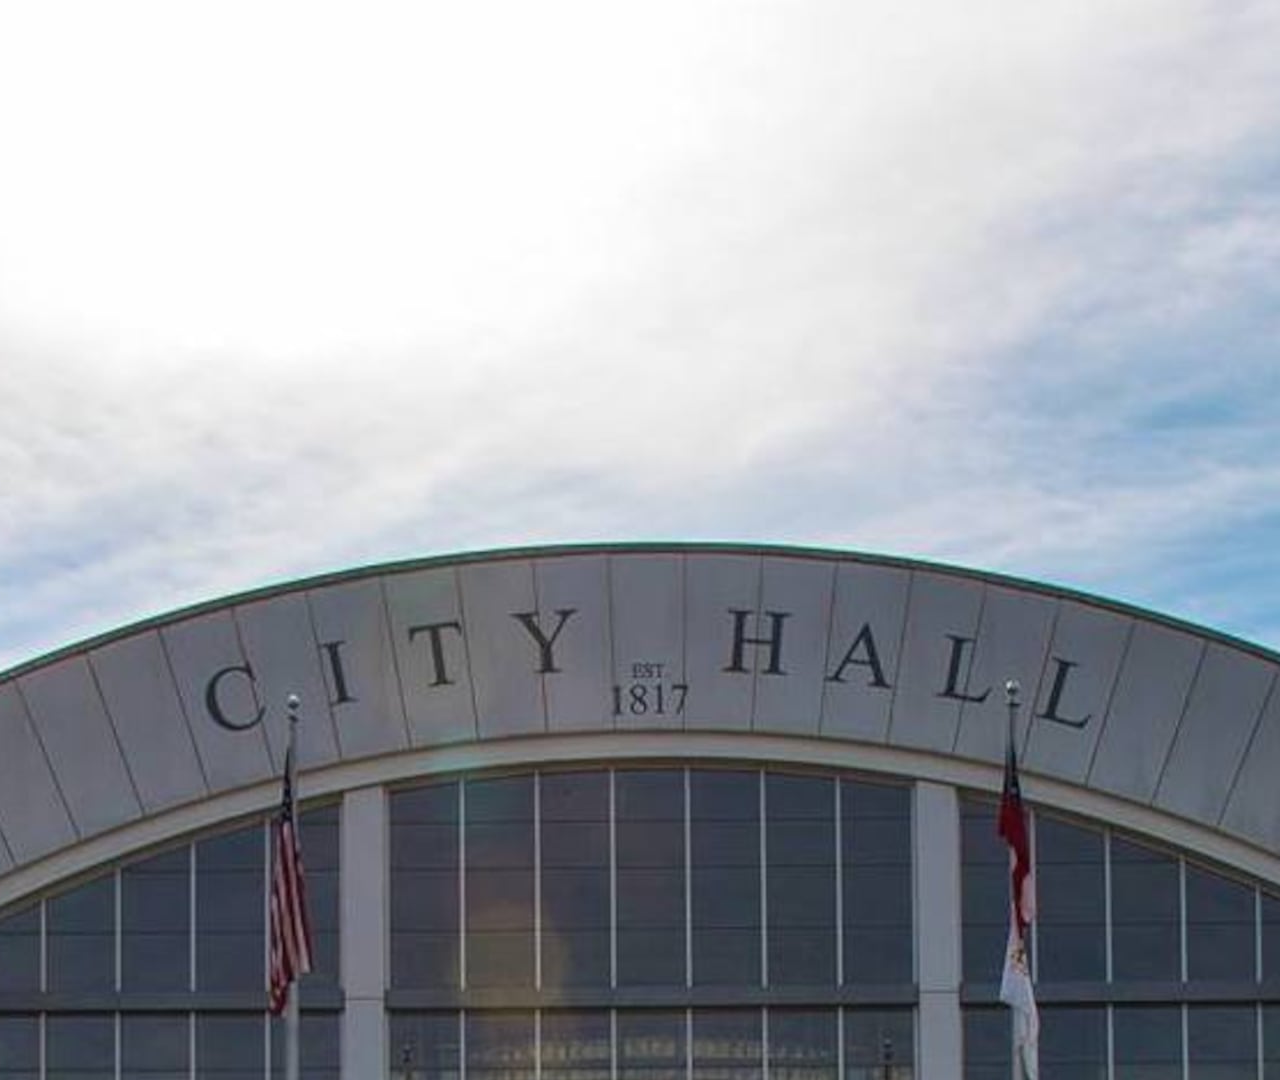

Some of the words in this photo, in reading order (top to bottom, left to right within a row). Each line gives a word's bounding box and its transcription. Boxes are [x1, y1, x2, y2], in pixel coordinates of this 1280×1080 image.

[205, 608, 578, 732] CITY
[722, 608, 1092, 730] HALL
[612, 683, 689, 716] 1817
